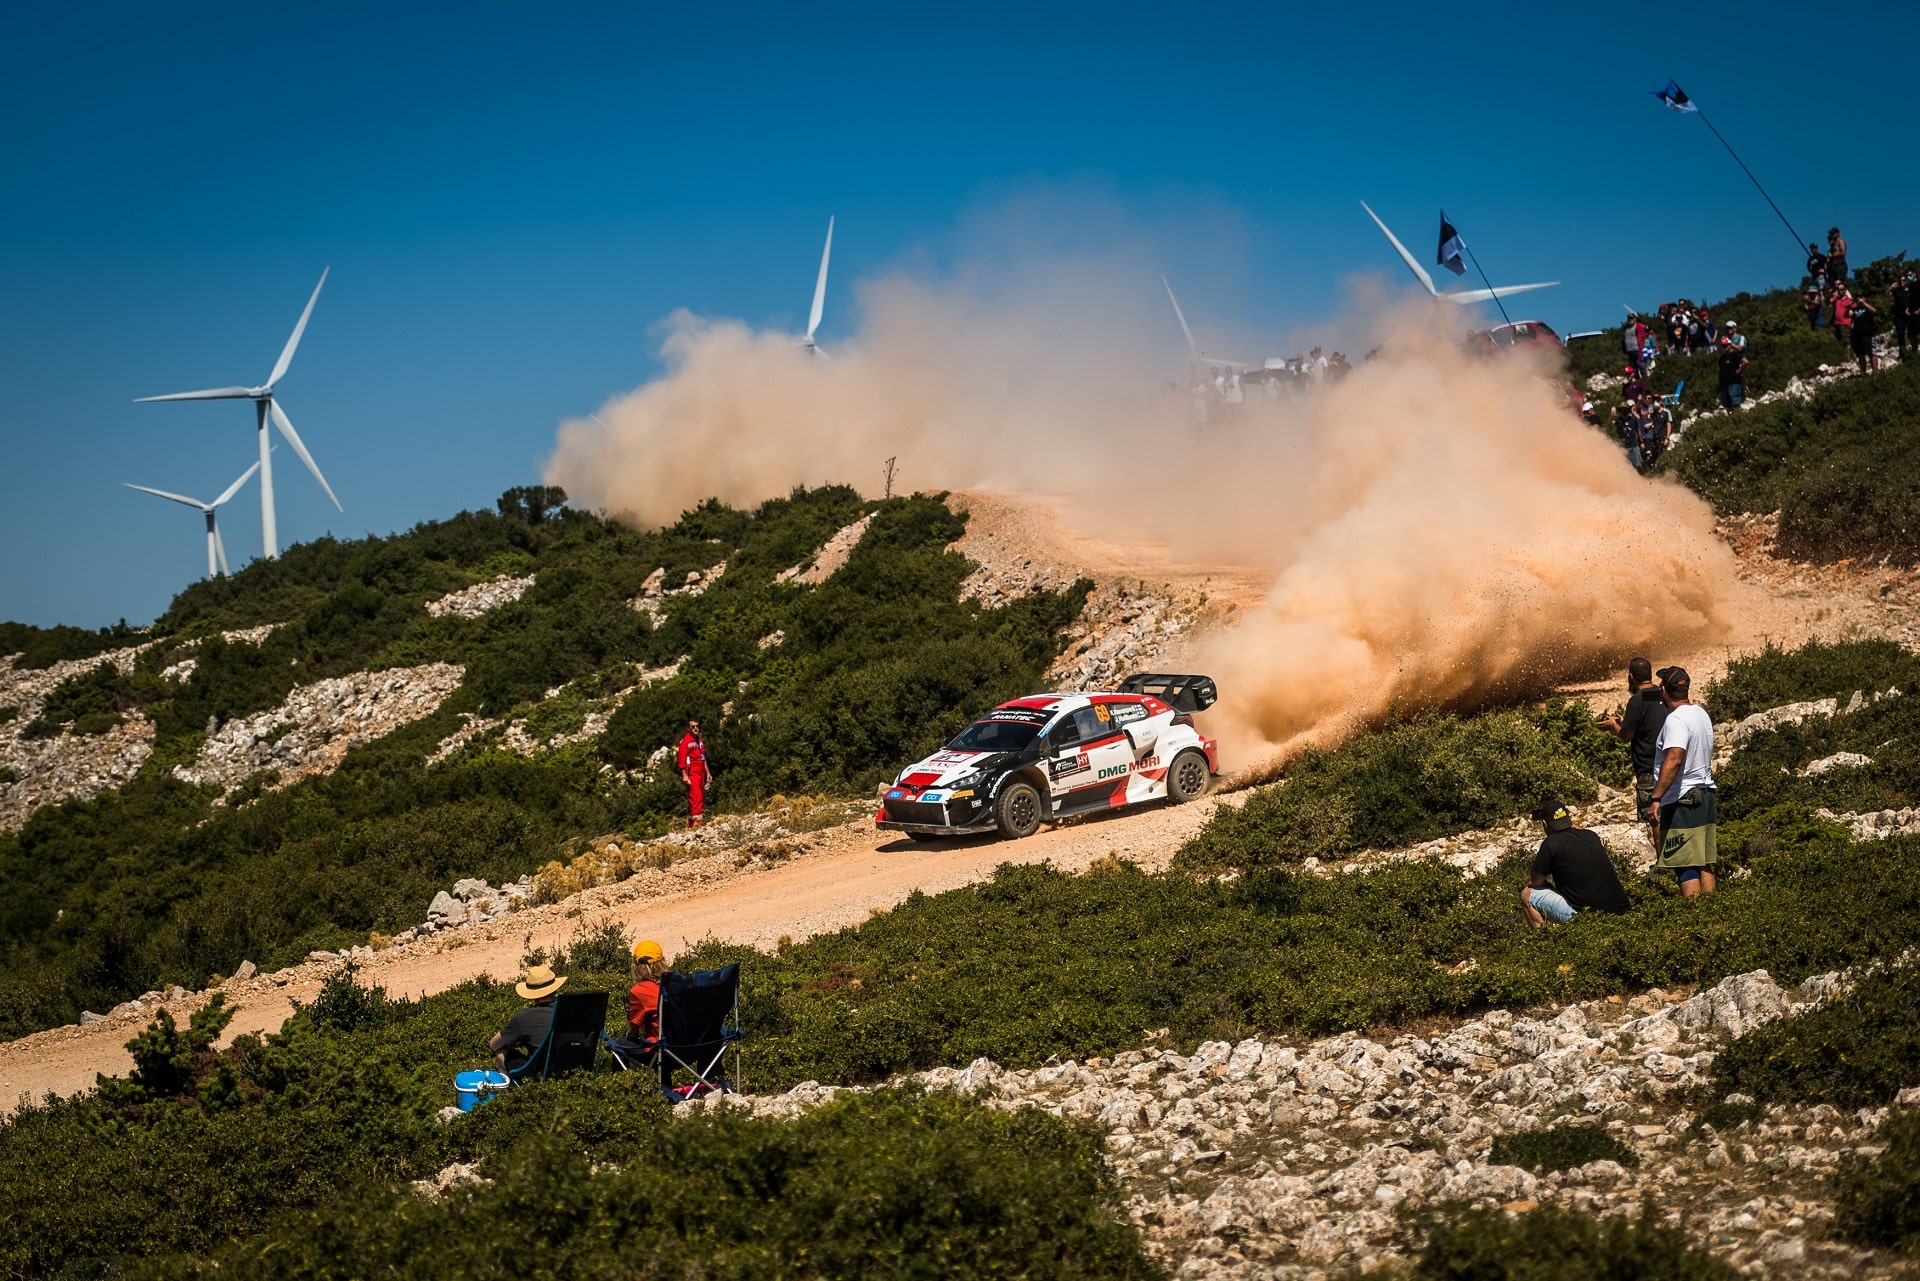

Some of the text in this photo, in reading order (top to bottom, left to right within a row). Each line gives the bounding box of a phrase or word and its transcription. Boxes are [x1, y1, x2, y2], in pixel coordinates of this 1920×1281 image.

[1094, 704, 1111, 723] 69
[1098, 764, 1127, 779] DMG
[1129, 756, 1160, 771] MORI
[1665, 833, 1685, 850] NIKE
